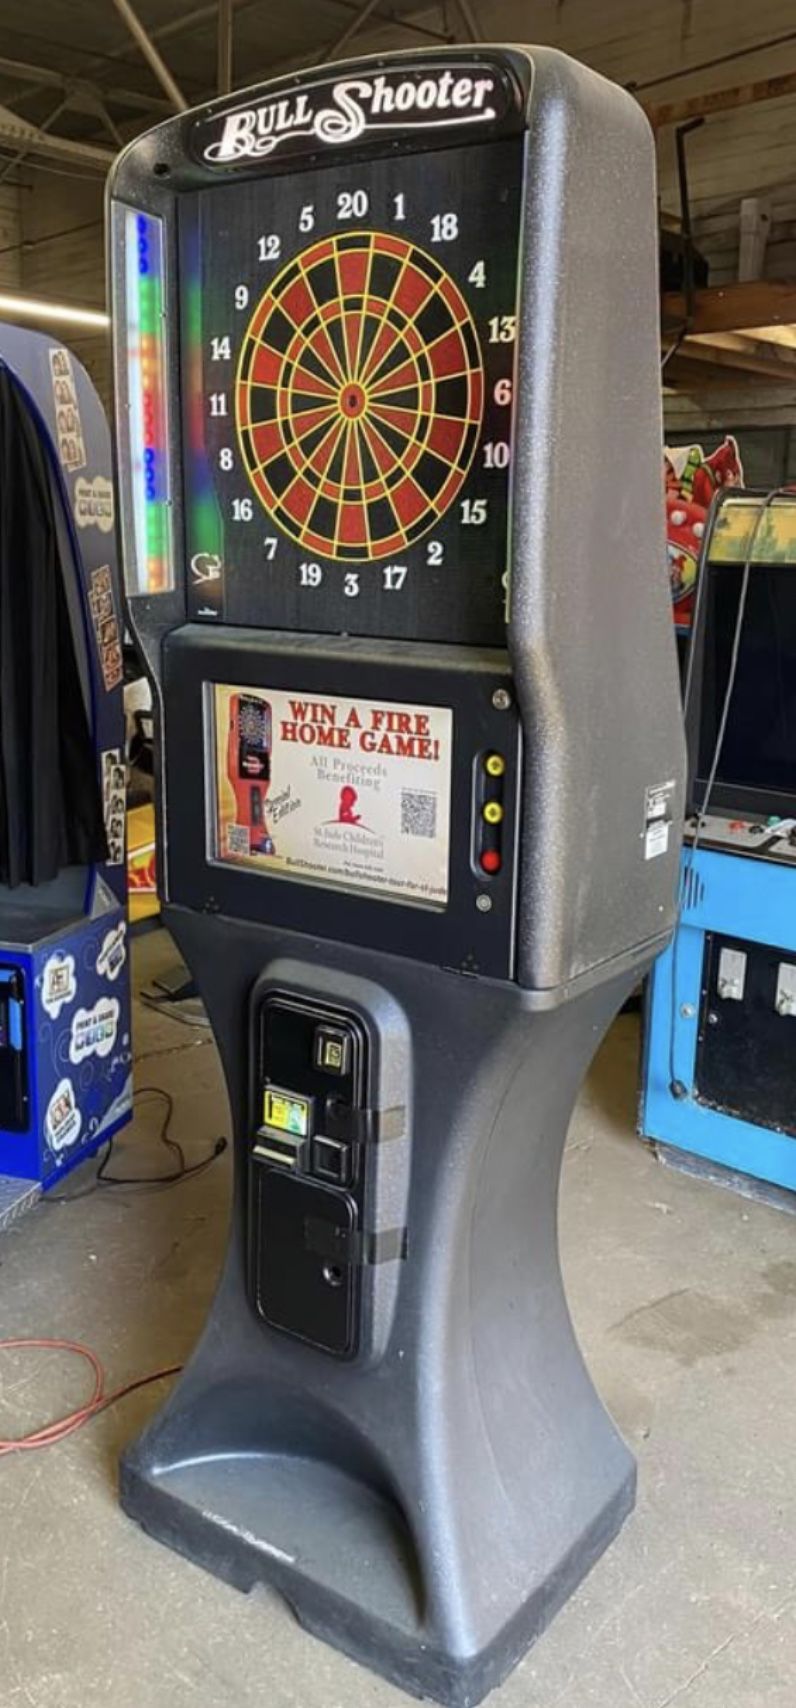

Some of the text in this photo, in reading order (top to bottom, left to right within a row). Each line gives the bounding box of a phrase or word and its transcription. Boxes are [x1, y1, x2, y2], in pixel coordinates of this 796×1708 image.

[314, 70, 496, 145] Shooter
[336, 190, 369, 219] 20
[393, 193, 406, 221] 1
[299, 205, 315, 232] 5
[430, 213, 460, 242] 18
[257, 234, 281, 262] 12
[468, 260, 487, 289] 4
[234, 284, 249, 311] 9
[488, 315, 516, 344] 13
[210, 337, 231, 361] 14
[209, 392, 228, 417] 11
[493, 378, 512, 406] 6
[219, 448, 234, 471] 8
[483, 442, 510, 469] 10
[231, 498, 254, 522] 16
[460, 499, 487, 525] 15
[264, 537, 279, 561] 7
[427, 541, 445, 567] 2
[299, 563, 322, 587] 19
[344, 573, 360, 597] 3
[383, 566, 408, 591] 17
[289, 701, 430, 736] WIN A FIRE
[281, 722, 440, 761] HOME GAME!
[311, 756, 388, 777] All Proceeds
[317, 768, 382, 792] Benefiting
